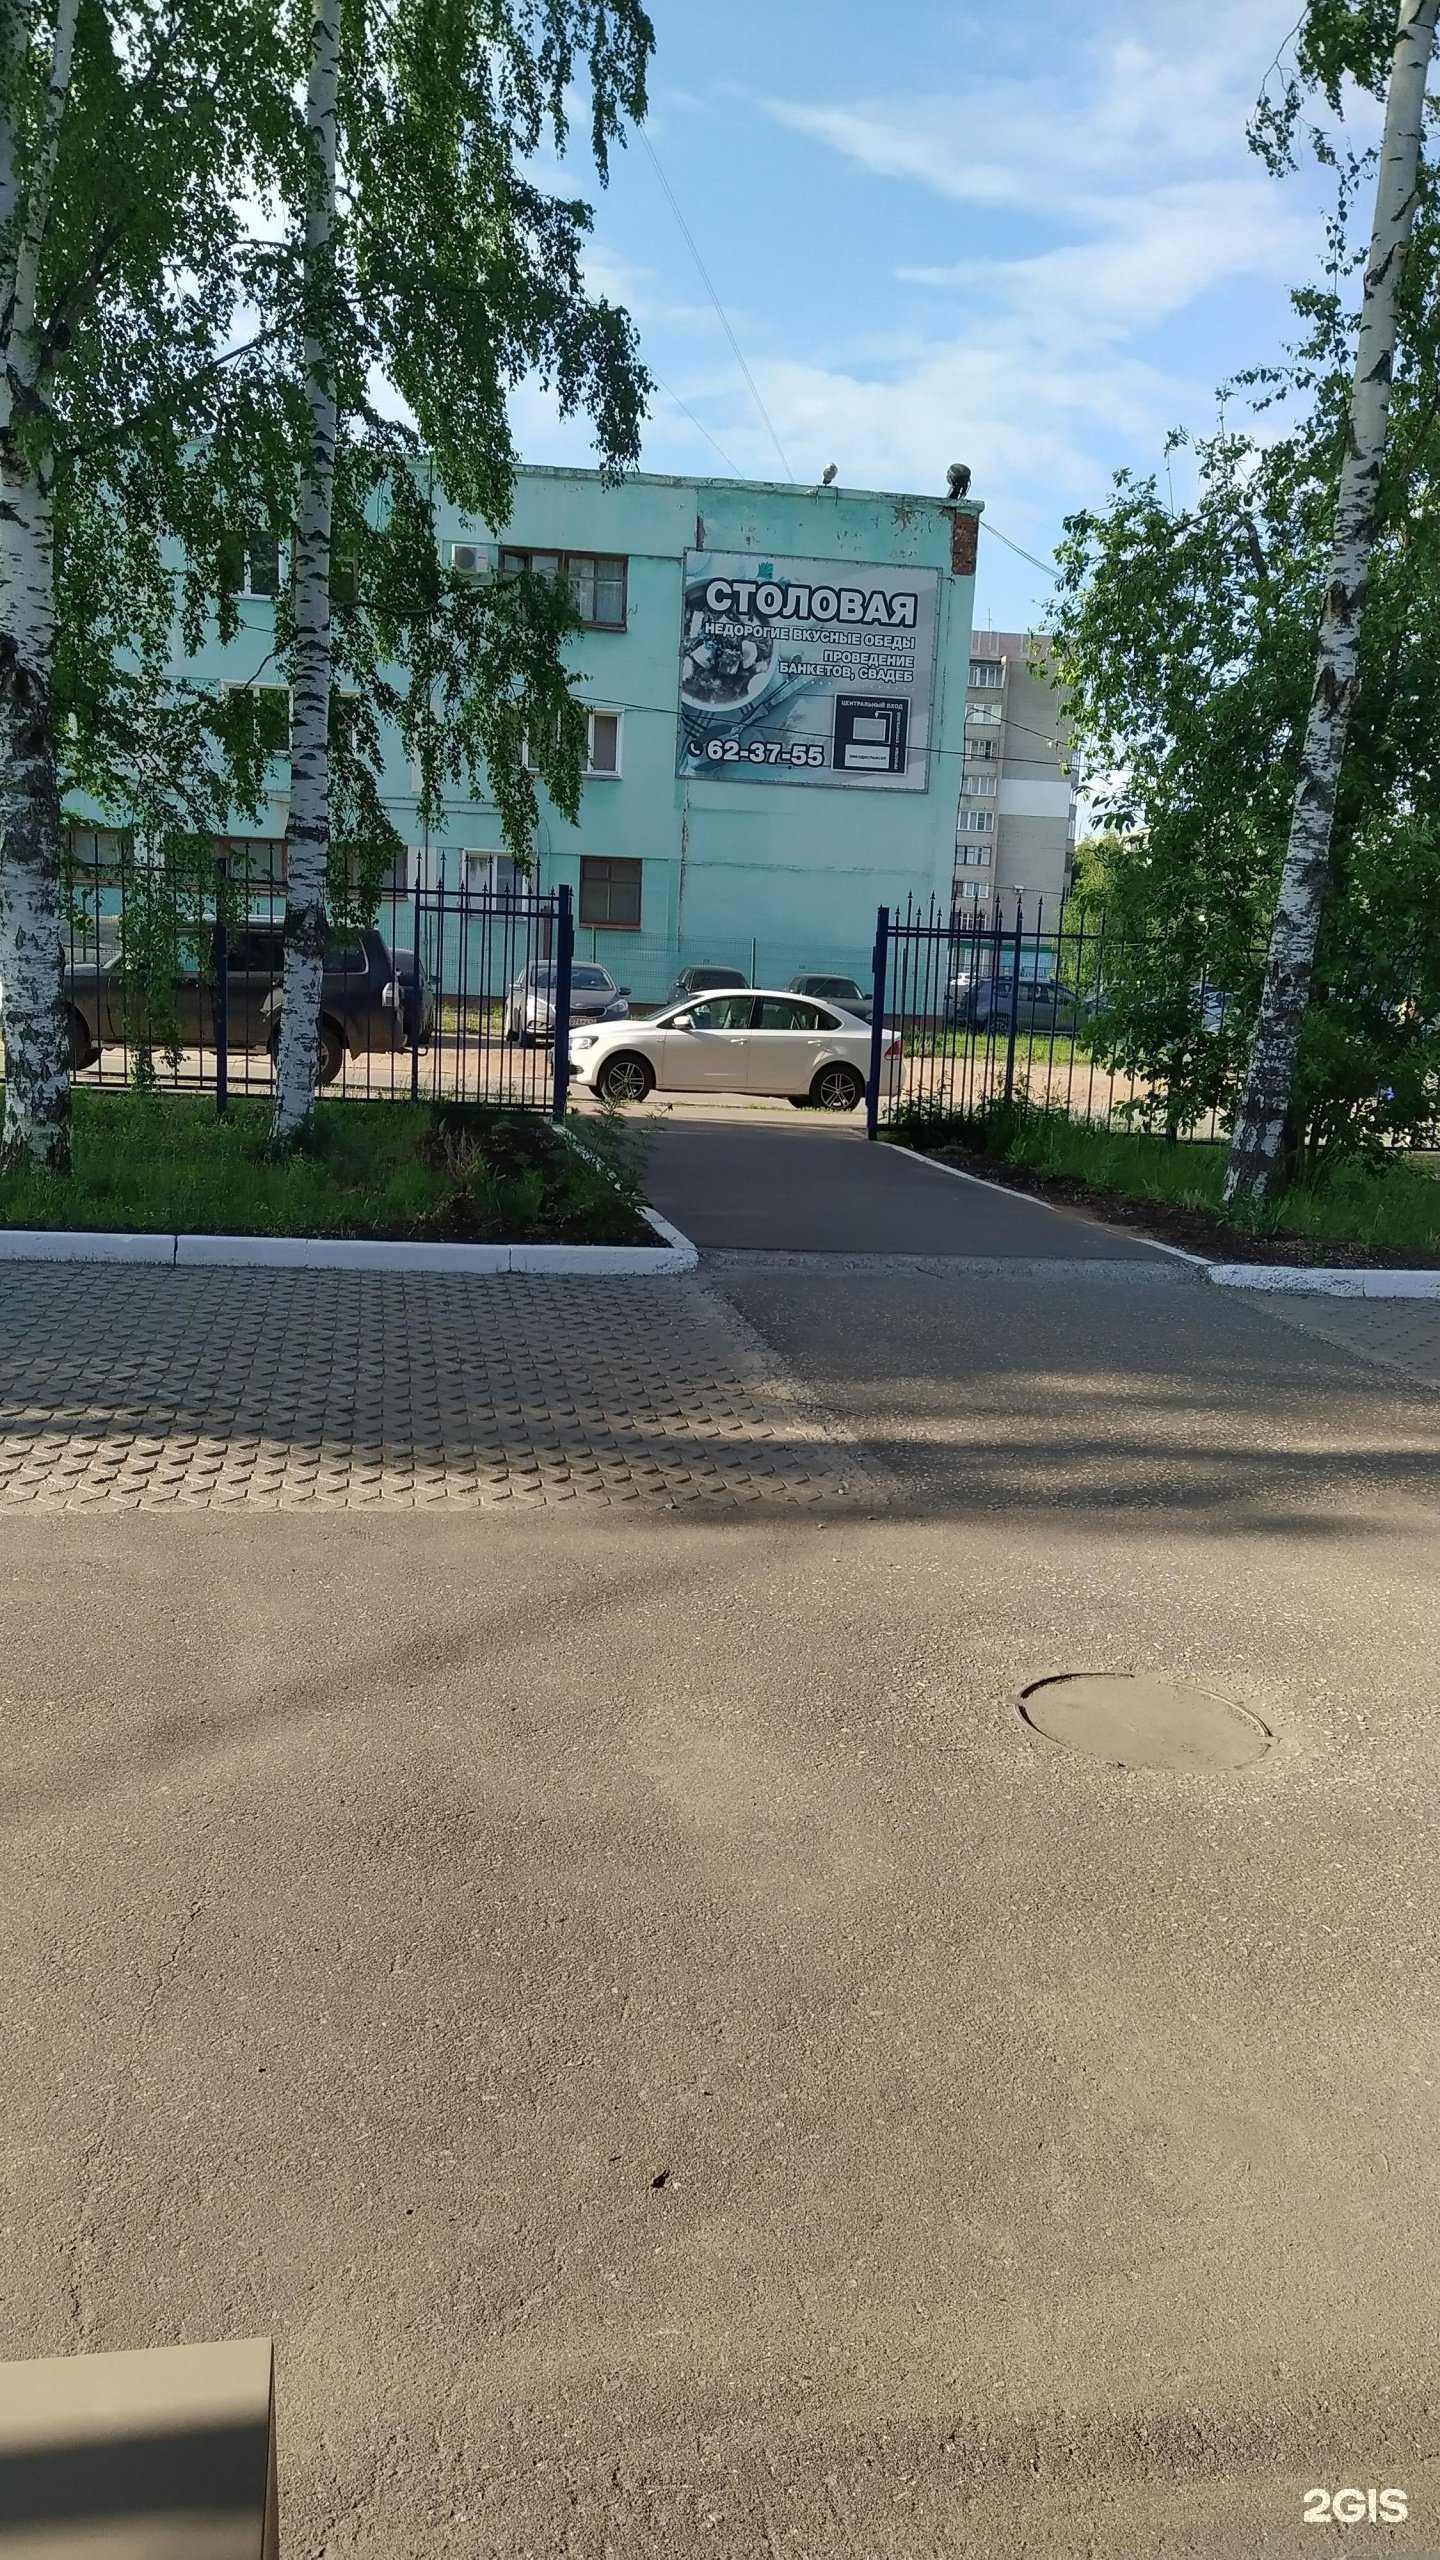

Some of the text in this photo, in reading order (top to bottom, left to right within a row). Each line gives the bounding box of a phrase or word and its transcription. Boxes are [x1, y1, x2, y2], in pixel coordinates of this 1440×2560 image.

[705, 579, 917, 626] СТОЛОВАЯ
[704, 622, 915, 650] НЕДОРОГИЕ ВКУСНЫЕ ОБЕДЫ
[823, 650, 914, 668] ПРОВЕДЕНИЕ
[779, 662, 913, 683] БАНКЕТОВ, СВАДЕБ
[841, 699, 886, 709] ЦЕНТРАЛЬНЫЙ
[706, 739, 825, 766] 62-37-55
